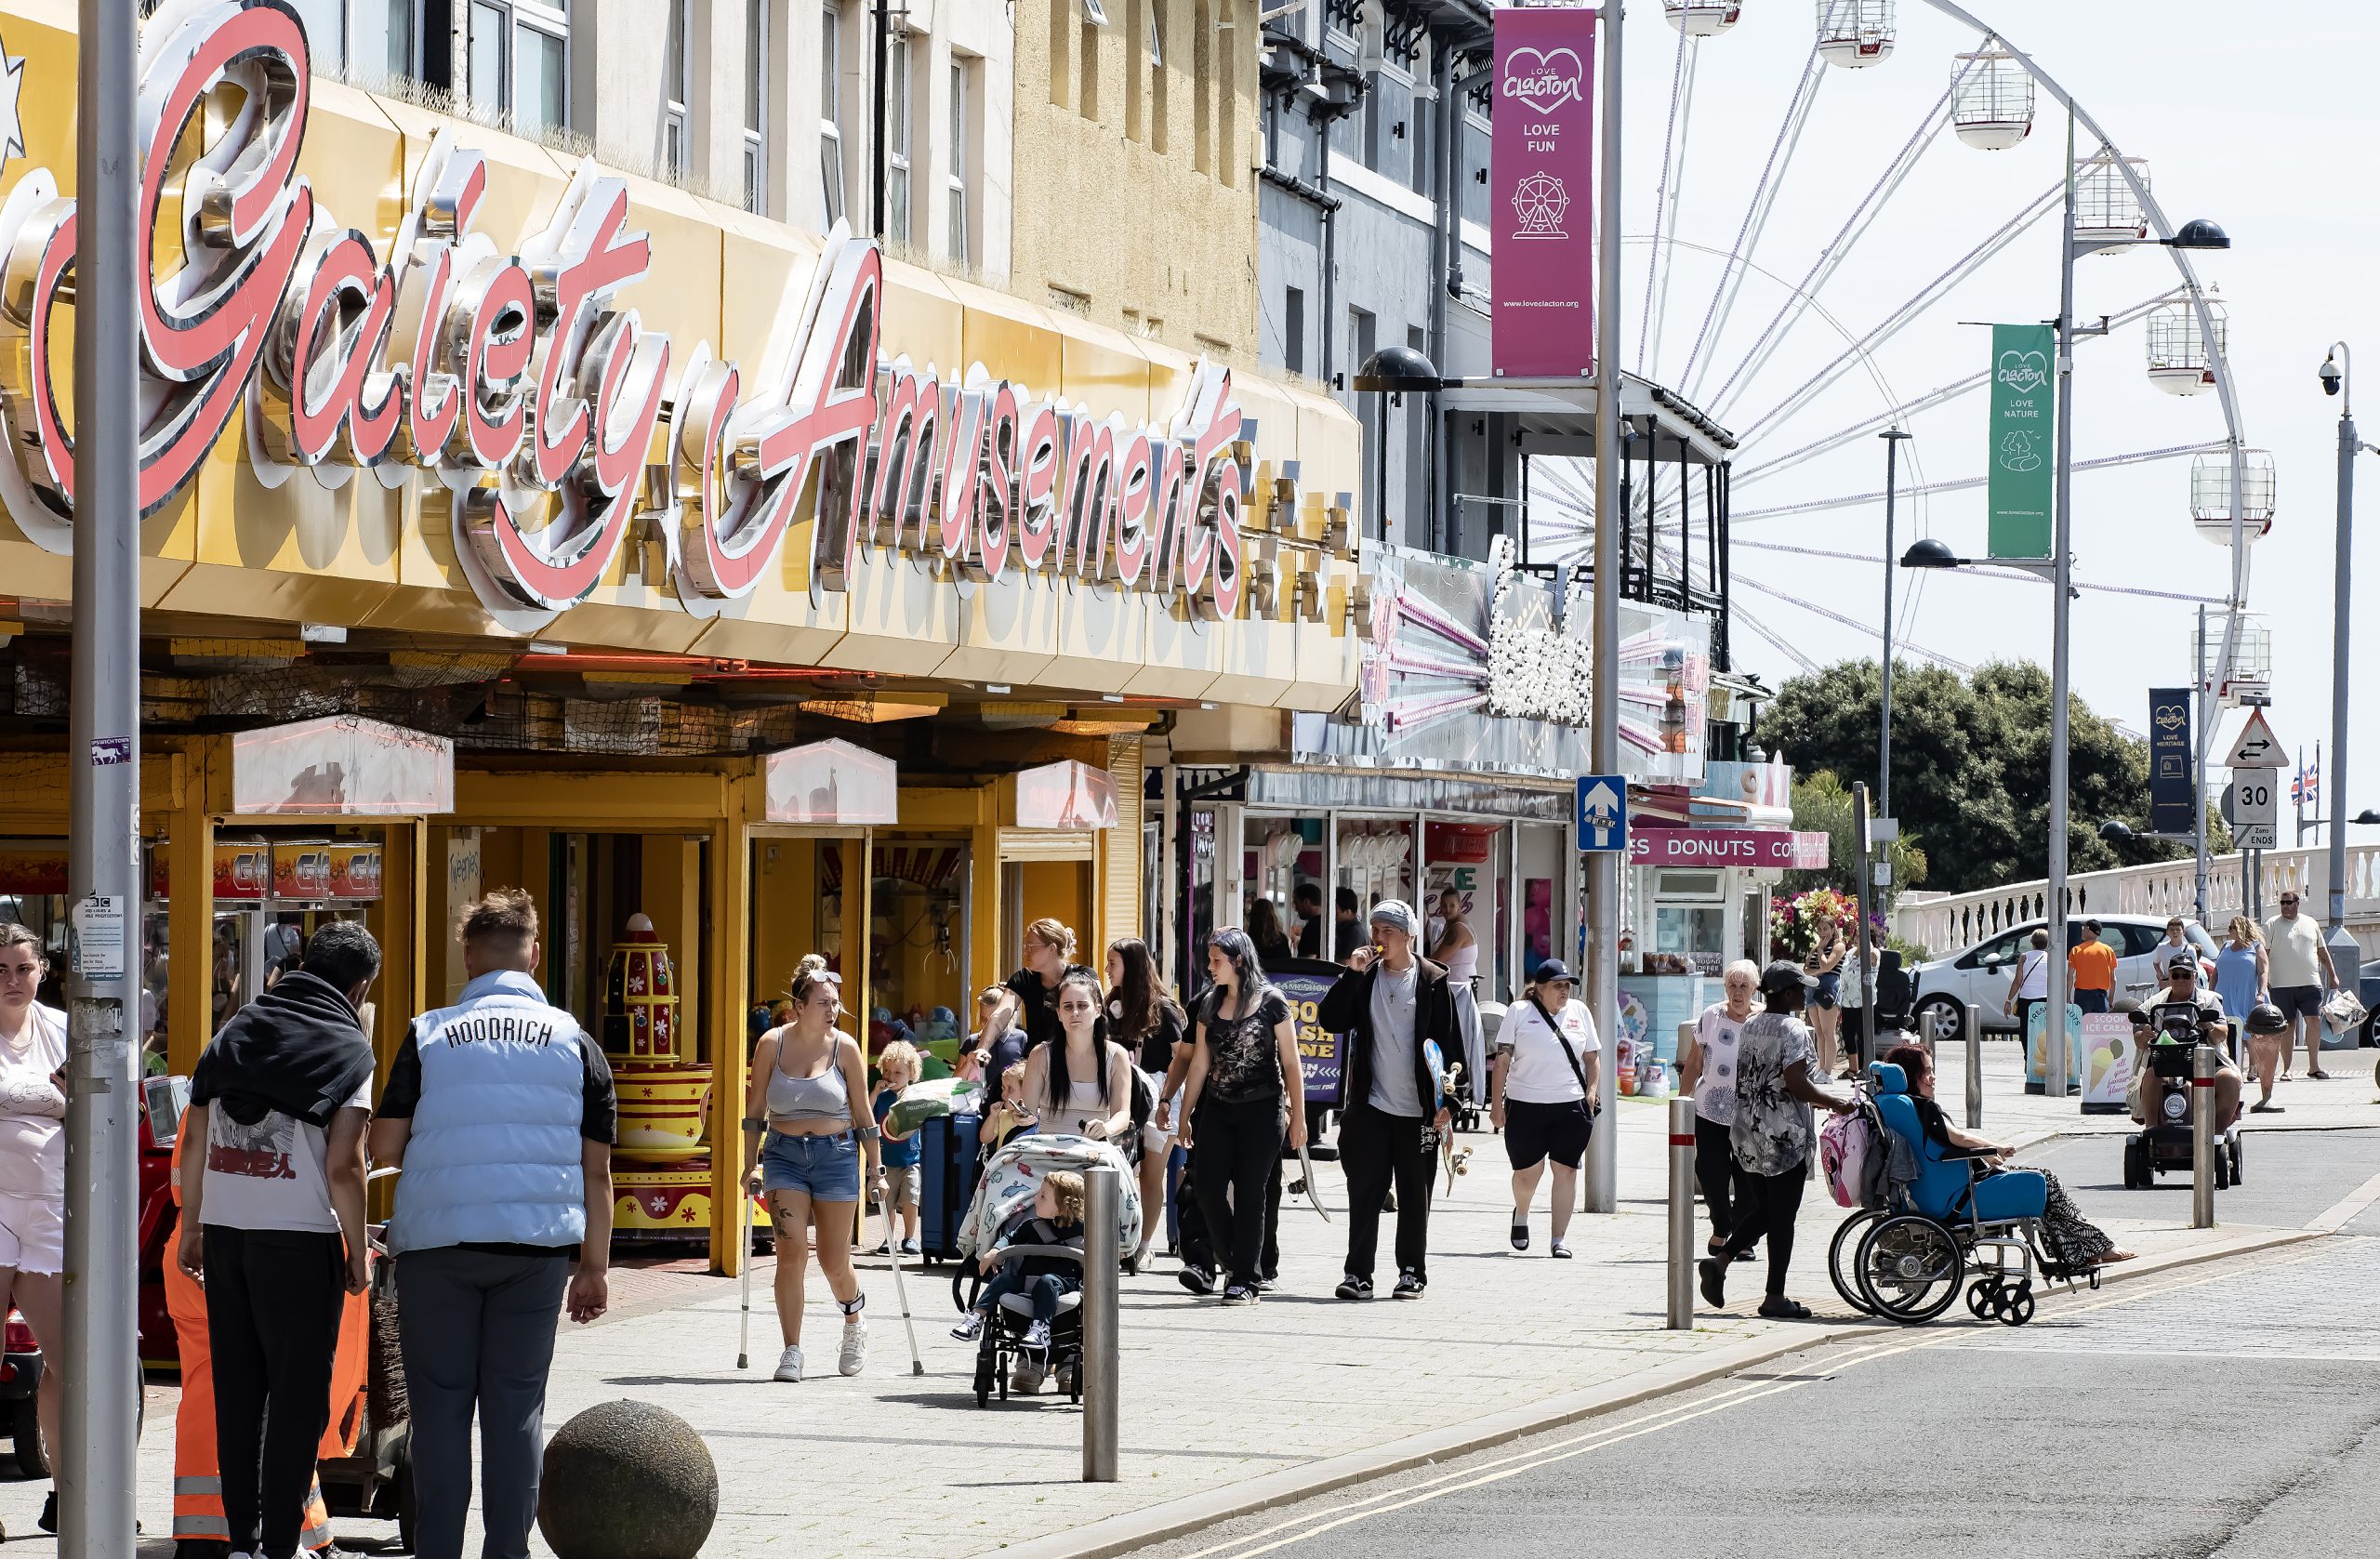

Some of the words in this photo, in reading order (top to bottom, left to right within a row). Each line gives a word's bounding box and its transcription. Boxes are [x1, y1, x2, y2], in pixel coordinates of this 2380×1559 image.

[1530, 67, 1557, 75] LOVE
[1524, 124, 1560, 136] LOVE
[1527, 140, 1555, 152] FUN
[1502, 299, 1580, 309] www.loveclacton.org
[14, 0, 671, 618] Gaiety
[697, 228, 1246, 621] Amusements
[2010, 399, 2034, 407] LOVE
[2003, 410, 2039, 418] NATURE
[2241, 786, 2268, 806] 30
[2251, 836, 2273, 844] ENDS
[1667, 839, 1756, 856] DONUTS
[2030, 1005, 2046, 1024] FRES
[2094, 1014, 2127, 1024] SCOOP
[444, 1017, 553, 1050] HOODRICH
[2085, 1024, 2101, 1033] ICE
[2113, 1068, 2130, 1078] your
[1322, 1082, 1336, 1090] roll
